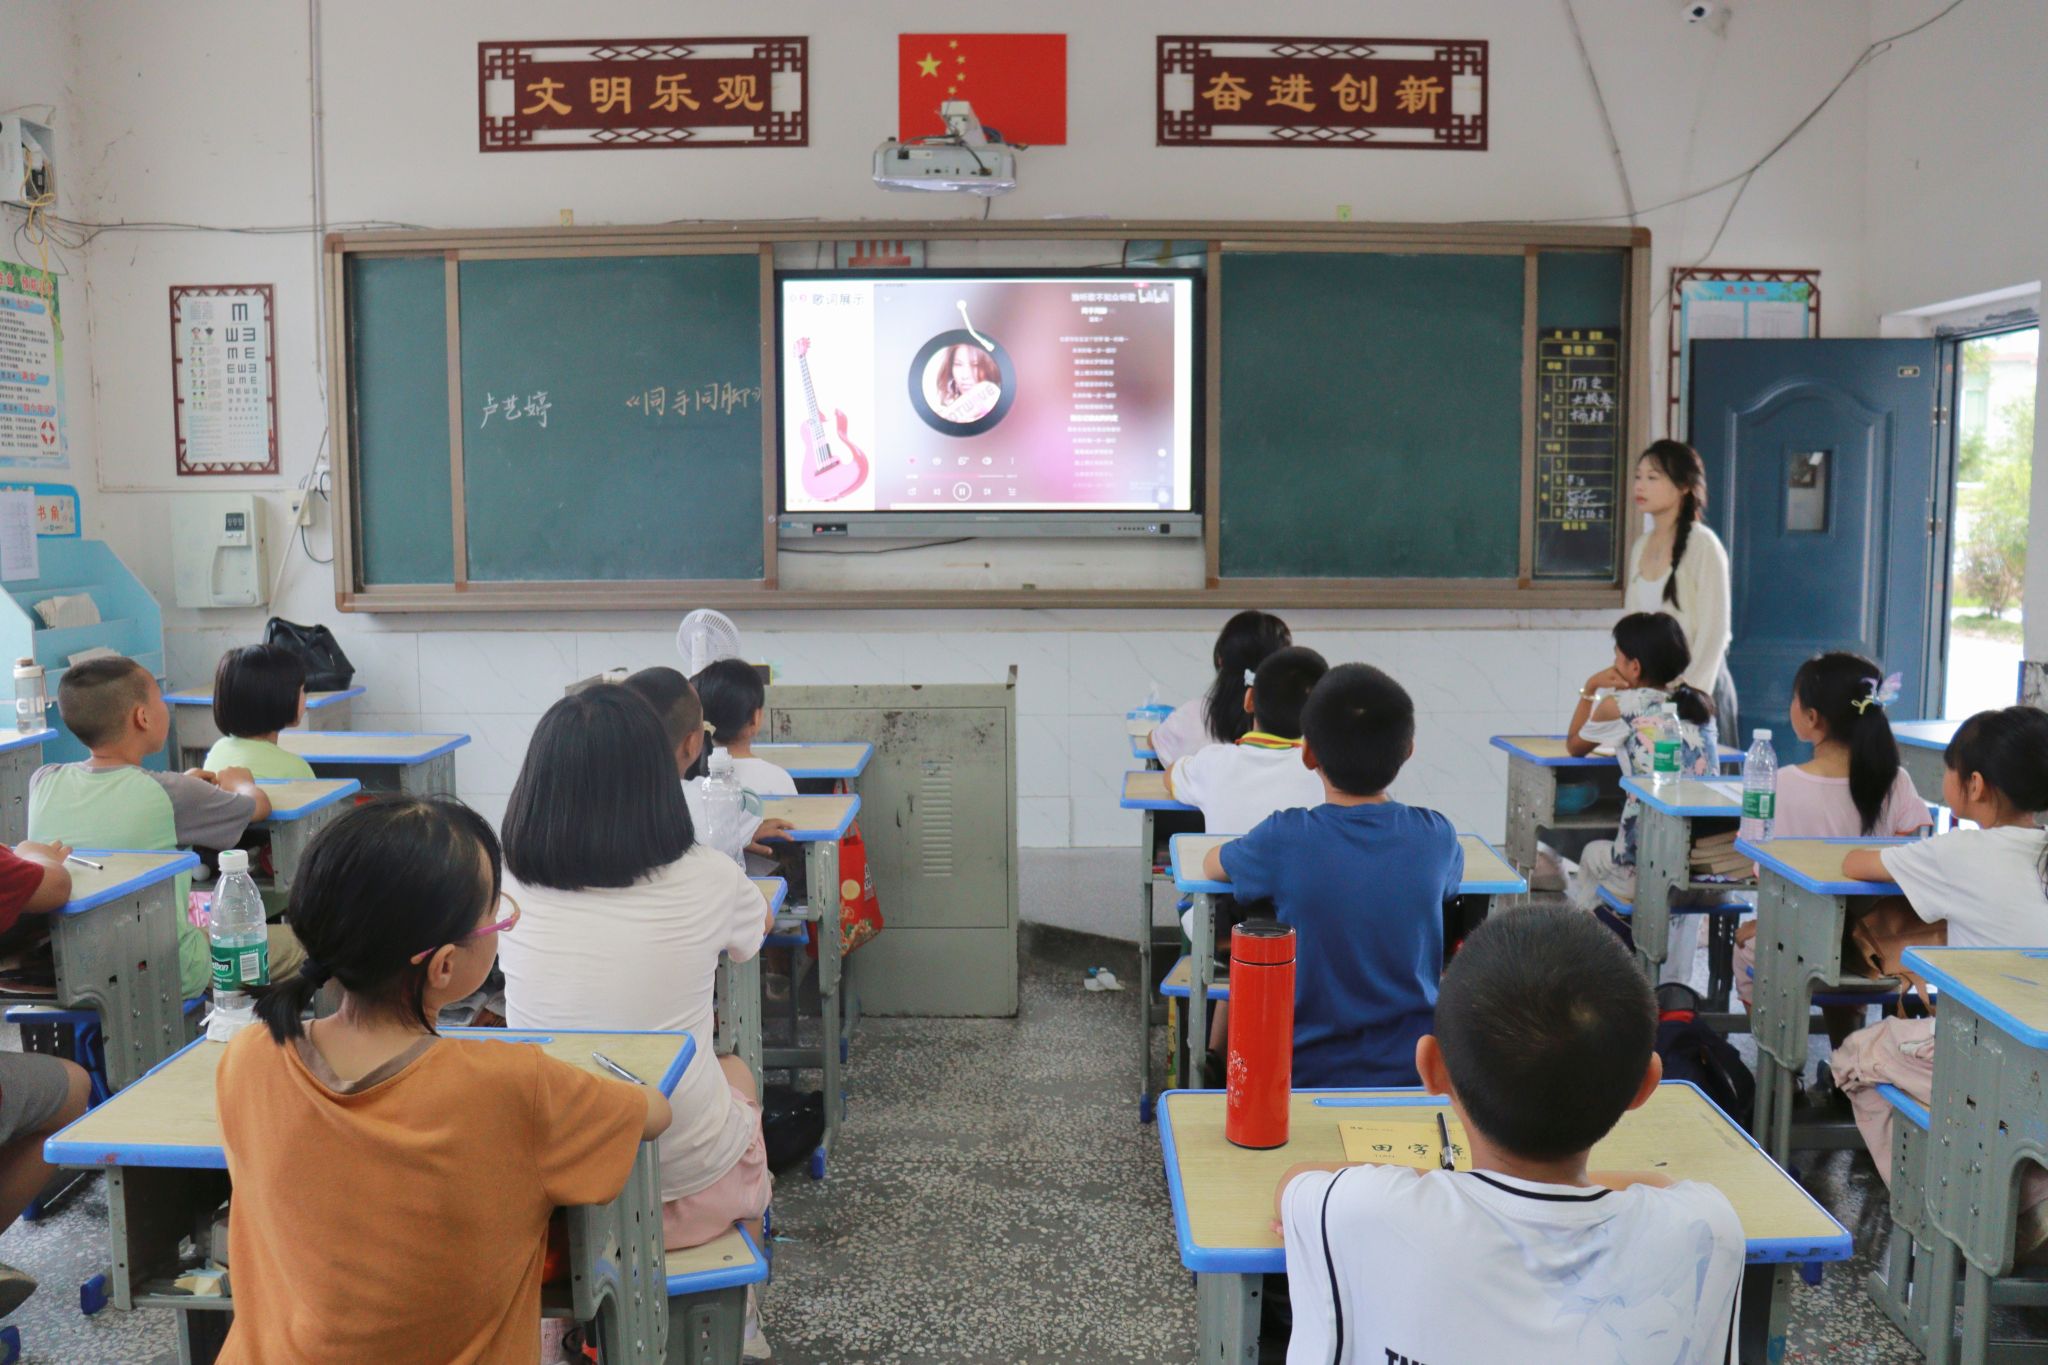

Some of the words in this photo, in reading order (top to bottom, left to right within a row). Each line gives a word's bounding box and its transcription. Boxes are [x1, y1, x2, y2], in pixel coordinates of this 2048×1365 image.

[522, 72, 764, 116] 文明乐观
[1202, 71, 1445, 114] 奋进创新
[480, 391, 552, 429] 卢艺婷
